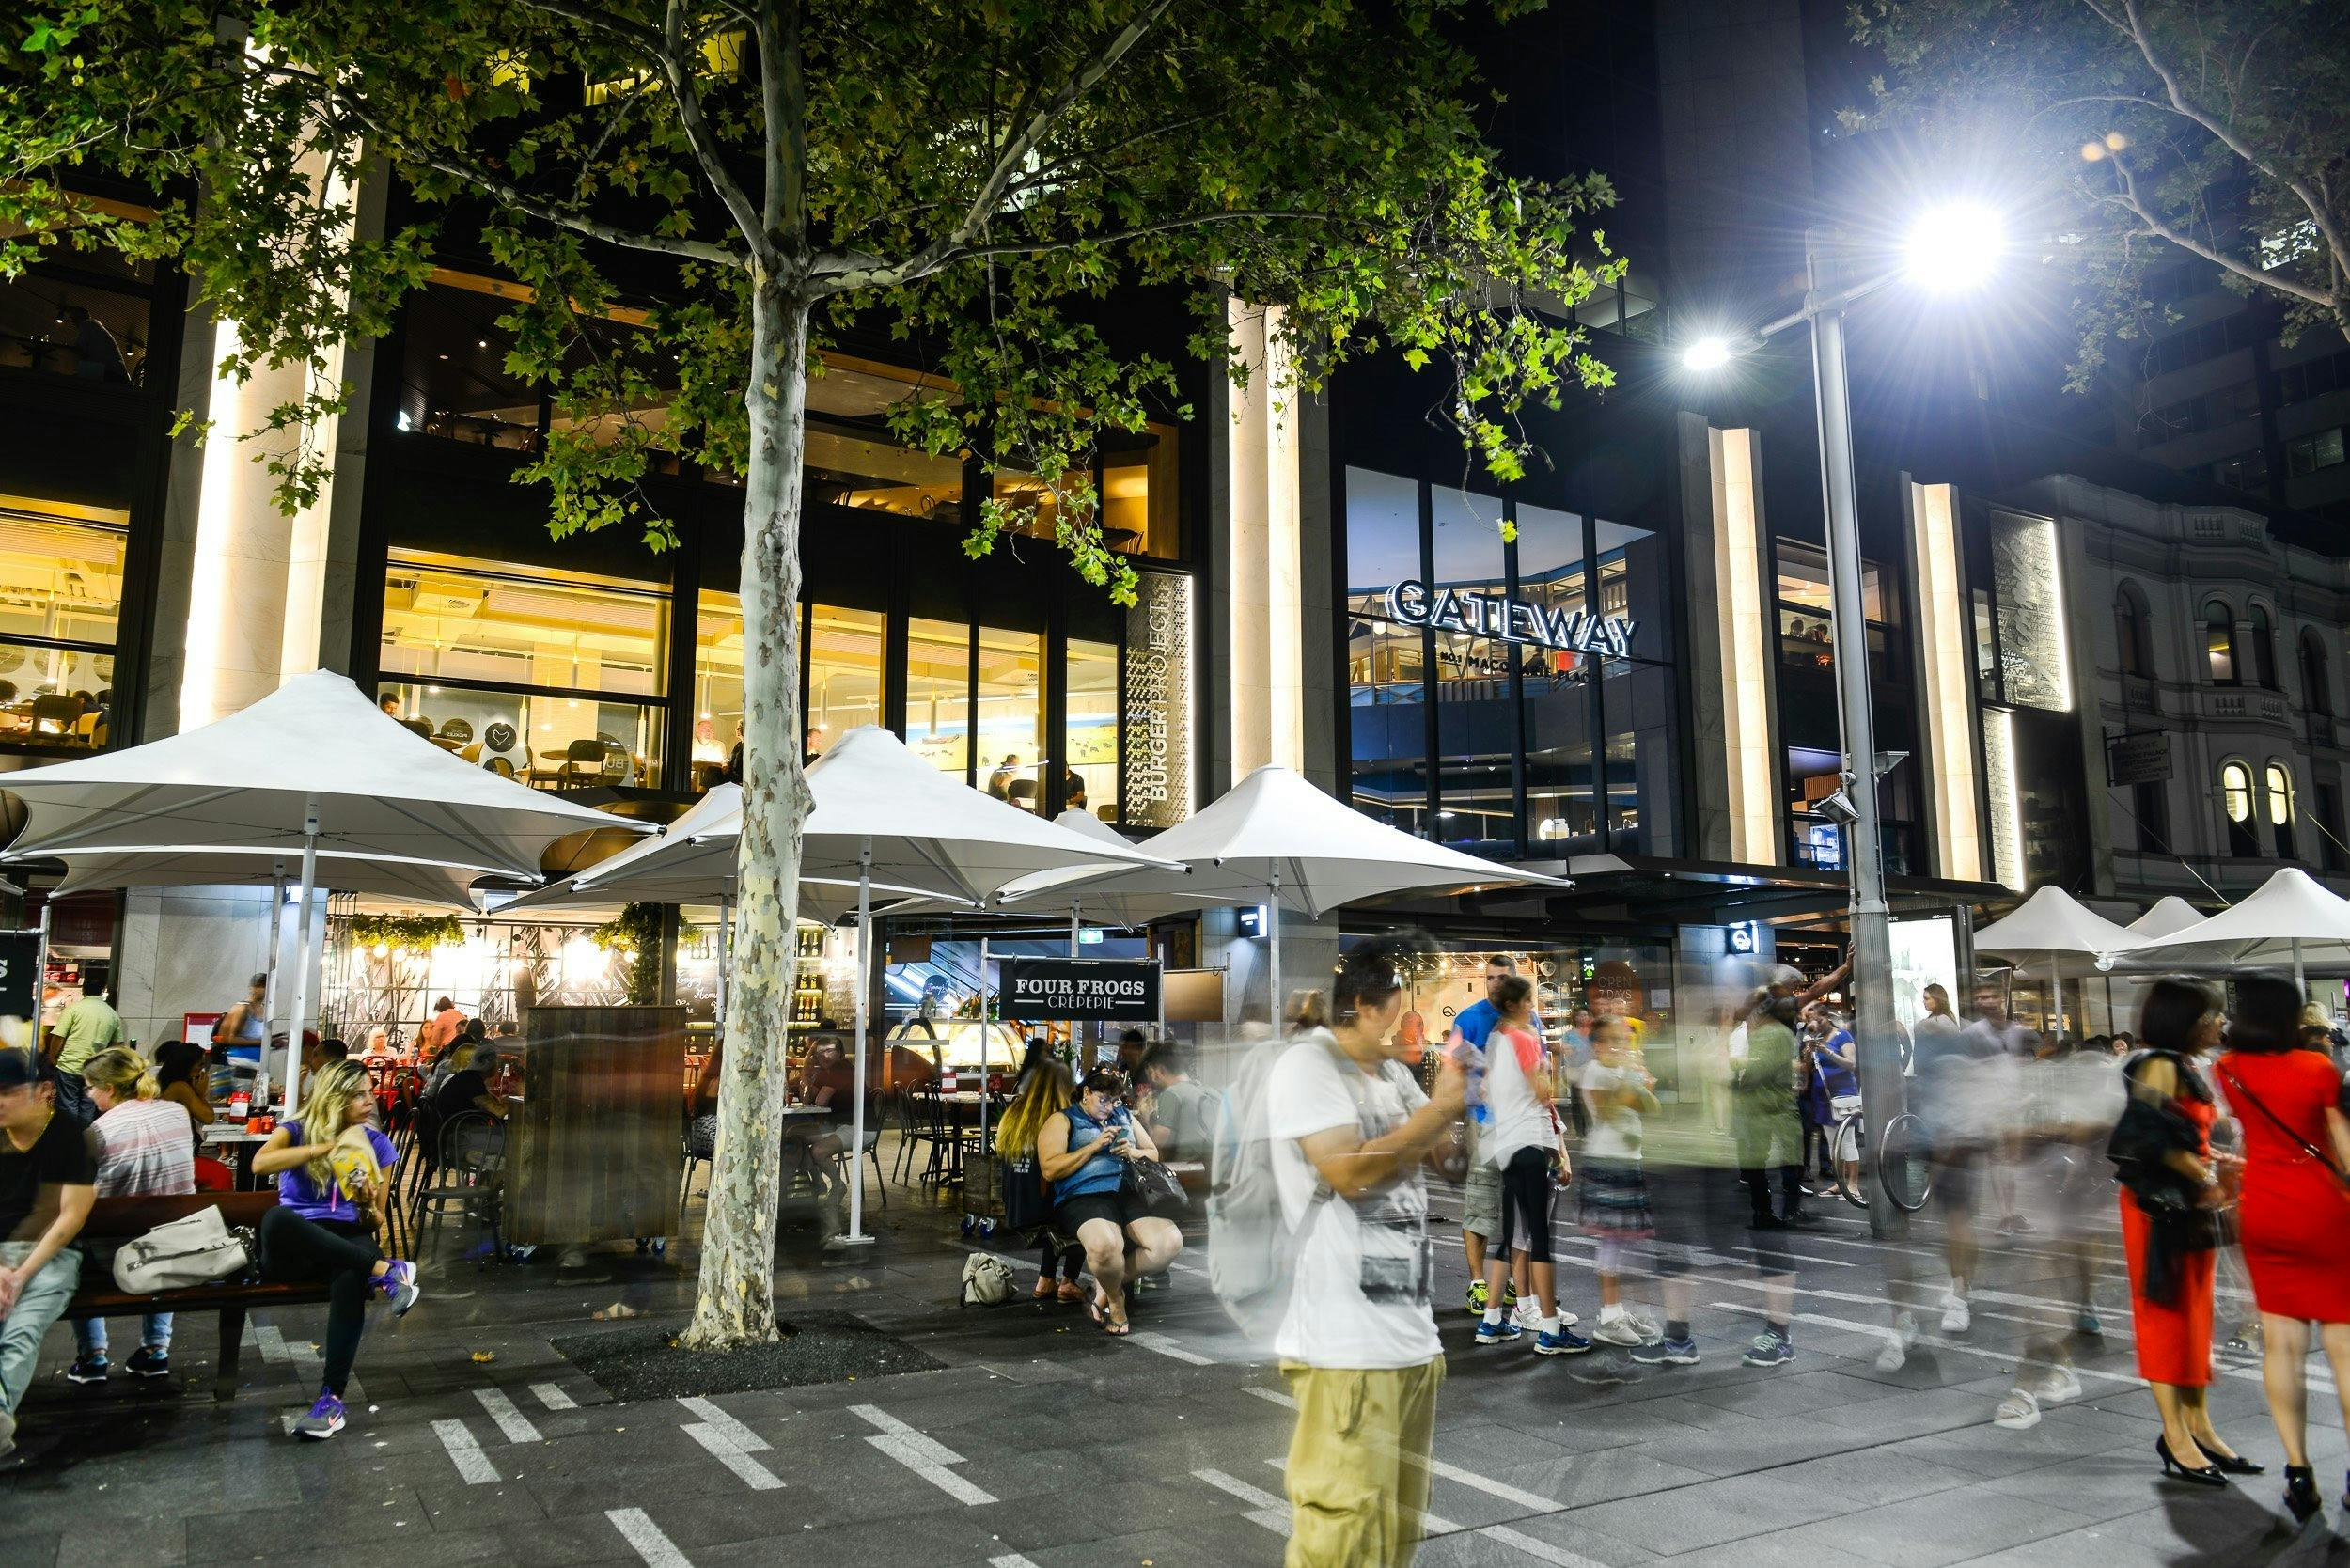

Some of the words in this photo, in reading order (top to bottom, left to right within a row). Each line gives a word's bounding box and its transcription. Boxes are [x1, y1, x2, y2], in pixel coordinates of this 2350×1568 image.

[1386, 578, 1641, 657] GATEWAY
[1149, 600, 1167, 703] PROJECT
[1468, 656, 1550, 678] MACQARIE
[1149, 710, 1167, 801] BURGER
[1015, 979, 1073, 994] FOUR
[1077, 980, 1145, 995] FROGS
[1598, 976, 1632, 988] OPEN
[1598, 989, 1605, 999] 7
[1606, 989, 1632, 999] DAYS
